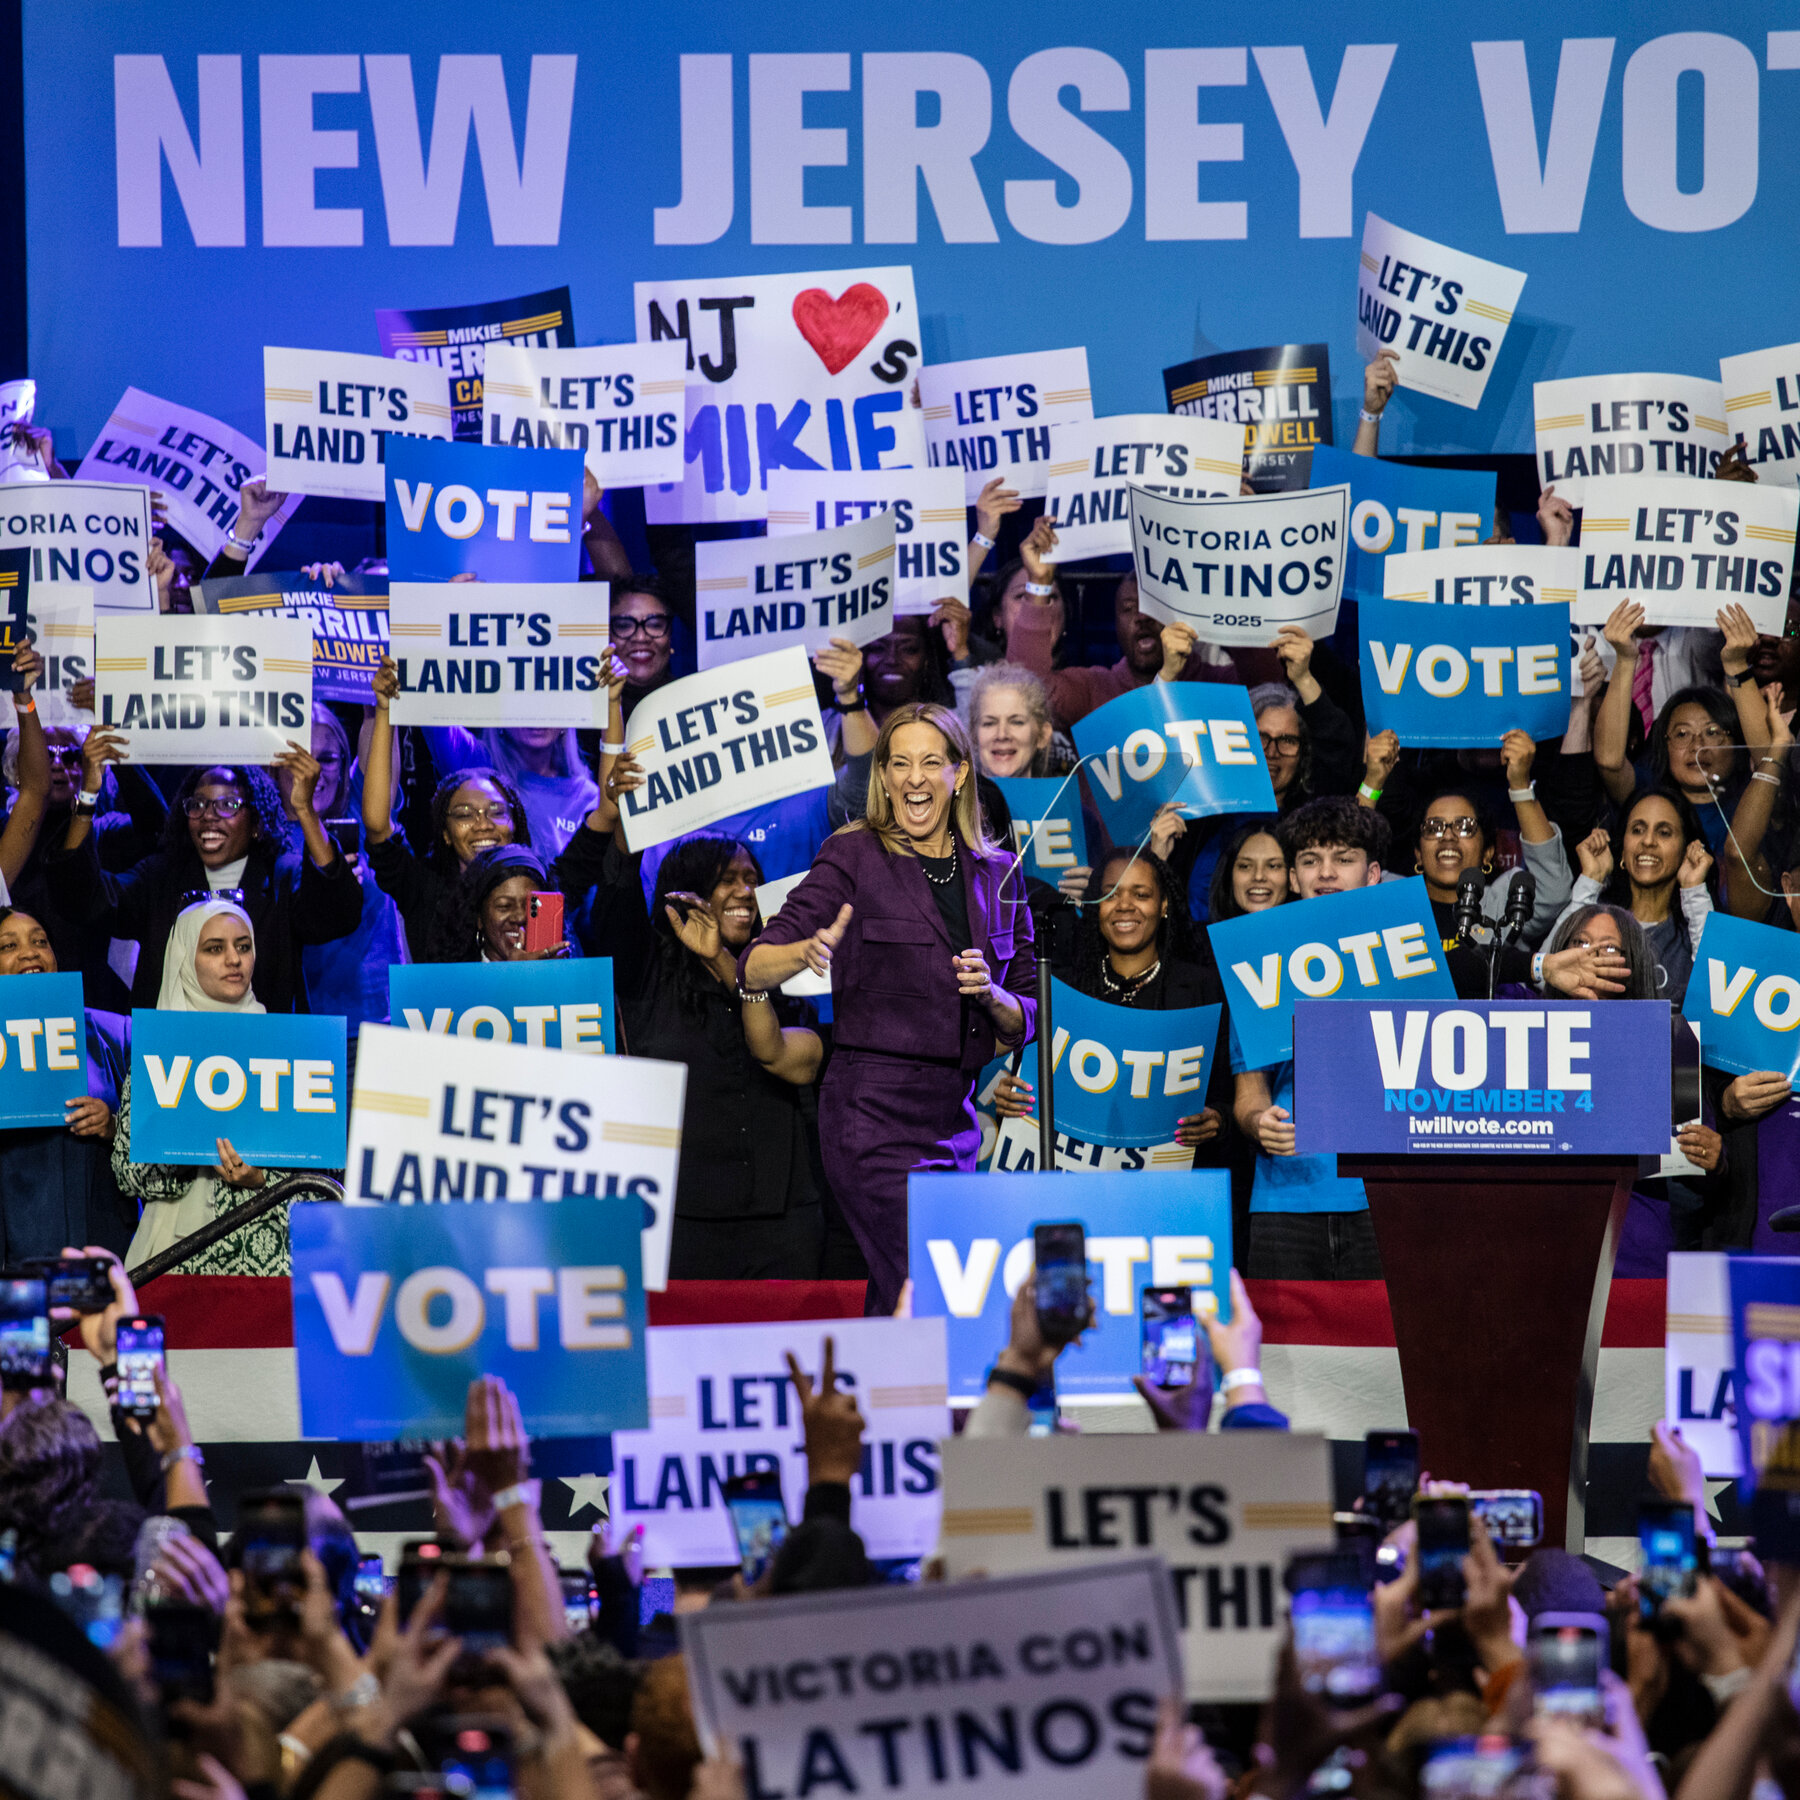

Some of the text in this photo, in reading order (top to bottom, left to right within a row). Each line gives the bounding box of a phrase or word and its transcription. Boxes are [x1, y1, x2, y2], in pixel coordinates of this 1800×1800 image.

[114, 31, 1800, 248] NEW JERSEY VO
[1378, 254, 1463, 316] LET'S
[447, 322, 504, 345] MIKIE
[648, 296, 755, 383] NJ
[1359, 286, 1491, 372] LAND THIS
[319, 380, 408, 422] LET'S
[540, 373, 634, 411] LET'S
[955, 382, 1039, 427] LET'S
[1207, 371, 1255, 394] MIKIE
[490, 413, 590, 451] LAND
[598, 412, 677, 453] THIS
[1244, 421, 1321, 448] DWELL
[1591, 399, 1690, 434] LET'S
[94, 440, 194, 492] LAND
[158, 424, 252, 492] LET'S
[273, 422, 366, 465] LAND
[1001, 424, 1051, 464] TH
[1094, 442, 1189, 480] LET'S
[1544, 441, 1645, 483] LAND
[85, 514, 139, 537] CON
[394, 478, 572, 544] VOTE
[1050, 490, 1129, 529] LAND
[1351, 499, 1481, 555] OTE
[1635, 506, 1740, 546] LET'S
[1139, 514, 1337, 551] VICTORIA CON
[33, 547, 140, 585] INOS
[755, 551, 853, 595] LET'S
[898, 540, 961, 579] HIS
[1143, 548, 1335, 599] LATINOS
[1583, 553, 1784, 598] LAND THIS
[282, 591, 336, 608] MIKIE
[705, 576, 890, 642] LAND THIS
[1212, 612, 1262, 628] 2025
[448, 612, 552, 648] LET'S
[153, 644, 257, 683] LET'S
[400, 655, 600, 695] LAND THIS
[1368, 640, 1561, 698] VOTE
[102, 691, 305, 730] LAND THIS
[657, 689, 760, 754] LET'S
[624, 717, 819, 818] LAND THIS
[1089, 719, 1257, 802] VOTE
[1231, 922, 1437, 1010] VOTE
[1708, 957, 1800, 1033] VO
[0, 1017, 79, 1072] TE
[1370, 1010, 1592, 1091] VOTE
[143, 1054, 336, 1113] VOTE
[1384, 1089, 1595, 1113] NOVEMBER 4
[440, 1083, 592, 1152] LET'S
[1409, 1116, 1554, 1135] iwillvote.com
[359, 1147, 508, 1204] LAND
[310, 1265, 632, 1356] VOTE
[1045, 1484, 1231, 1550] LET'S
[1172, 1565, 1274, 1629] THI
[719, 1622, 1153, 1710] VICTORIA CON
[739, 1690, 1158, 1800] LATINOS
